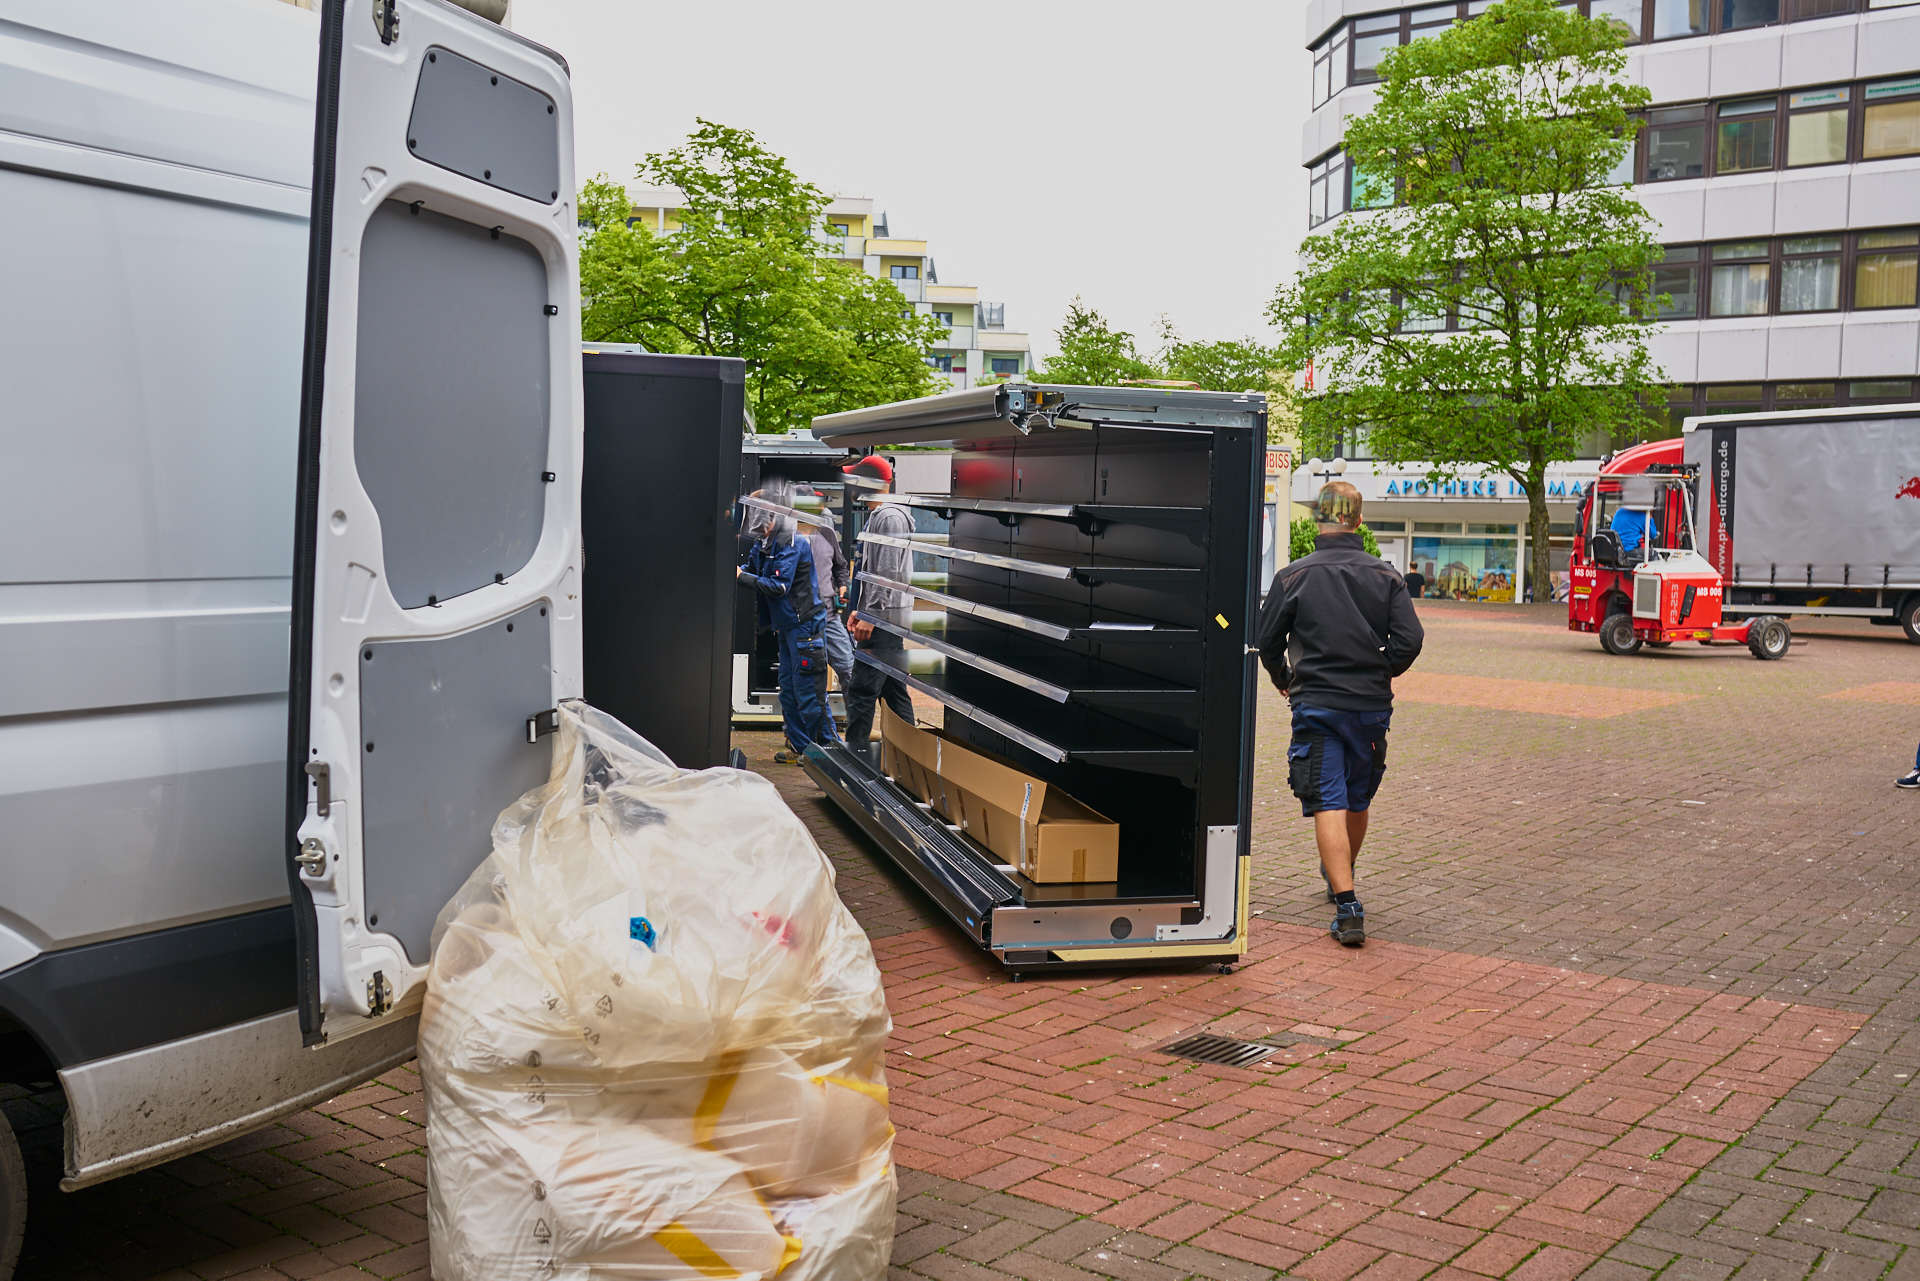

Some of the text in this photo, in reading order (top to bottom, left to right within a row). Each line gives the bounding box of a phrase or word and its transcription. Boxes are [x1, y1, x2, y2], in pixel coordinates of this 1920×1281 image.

[1386, 479, 1497, 496] APOTHEKE
[1718, 440, 1730, 575] www.pts-aircargo.de
[1574, 568, 1597, 578] MS 005
[1696, 587, 1722, 596] MS 005
[1670, 583, 1679, 624] F3-253
[583, 1026, 601, 1046] 24
[527, 1091, 546, 1104] 24
[536, 1259, 555, 1272] 24
